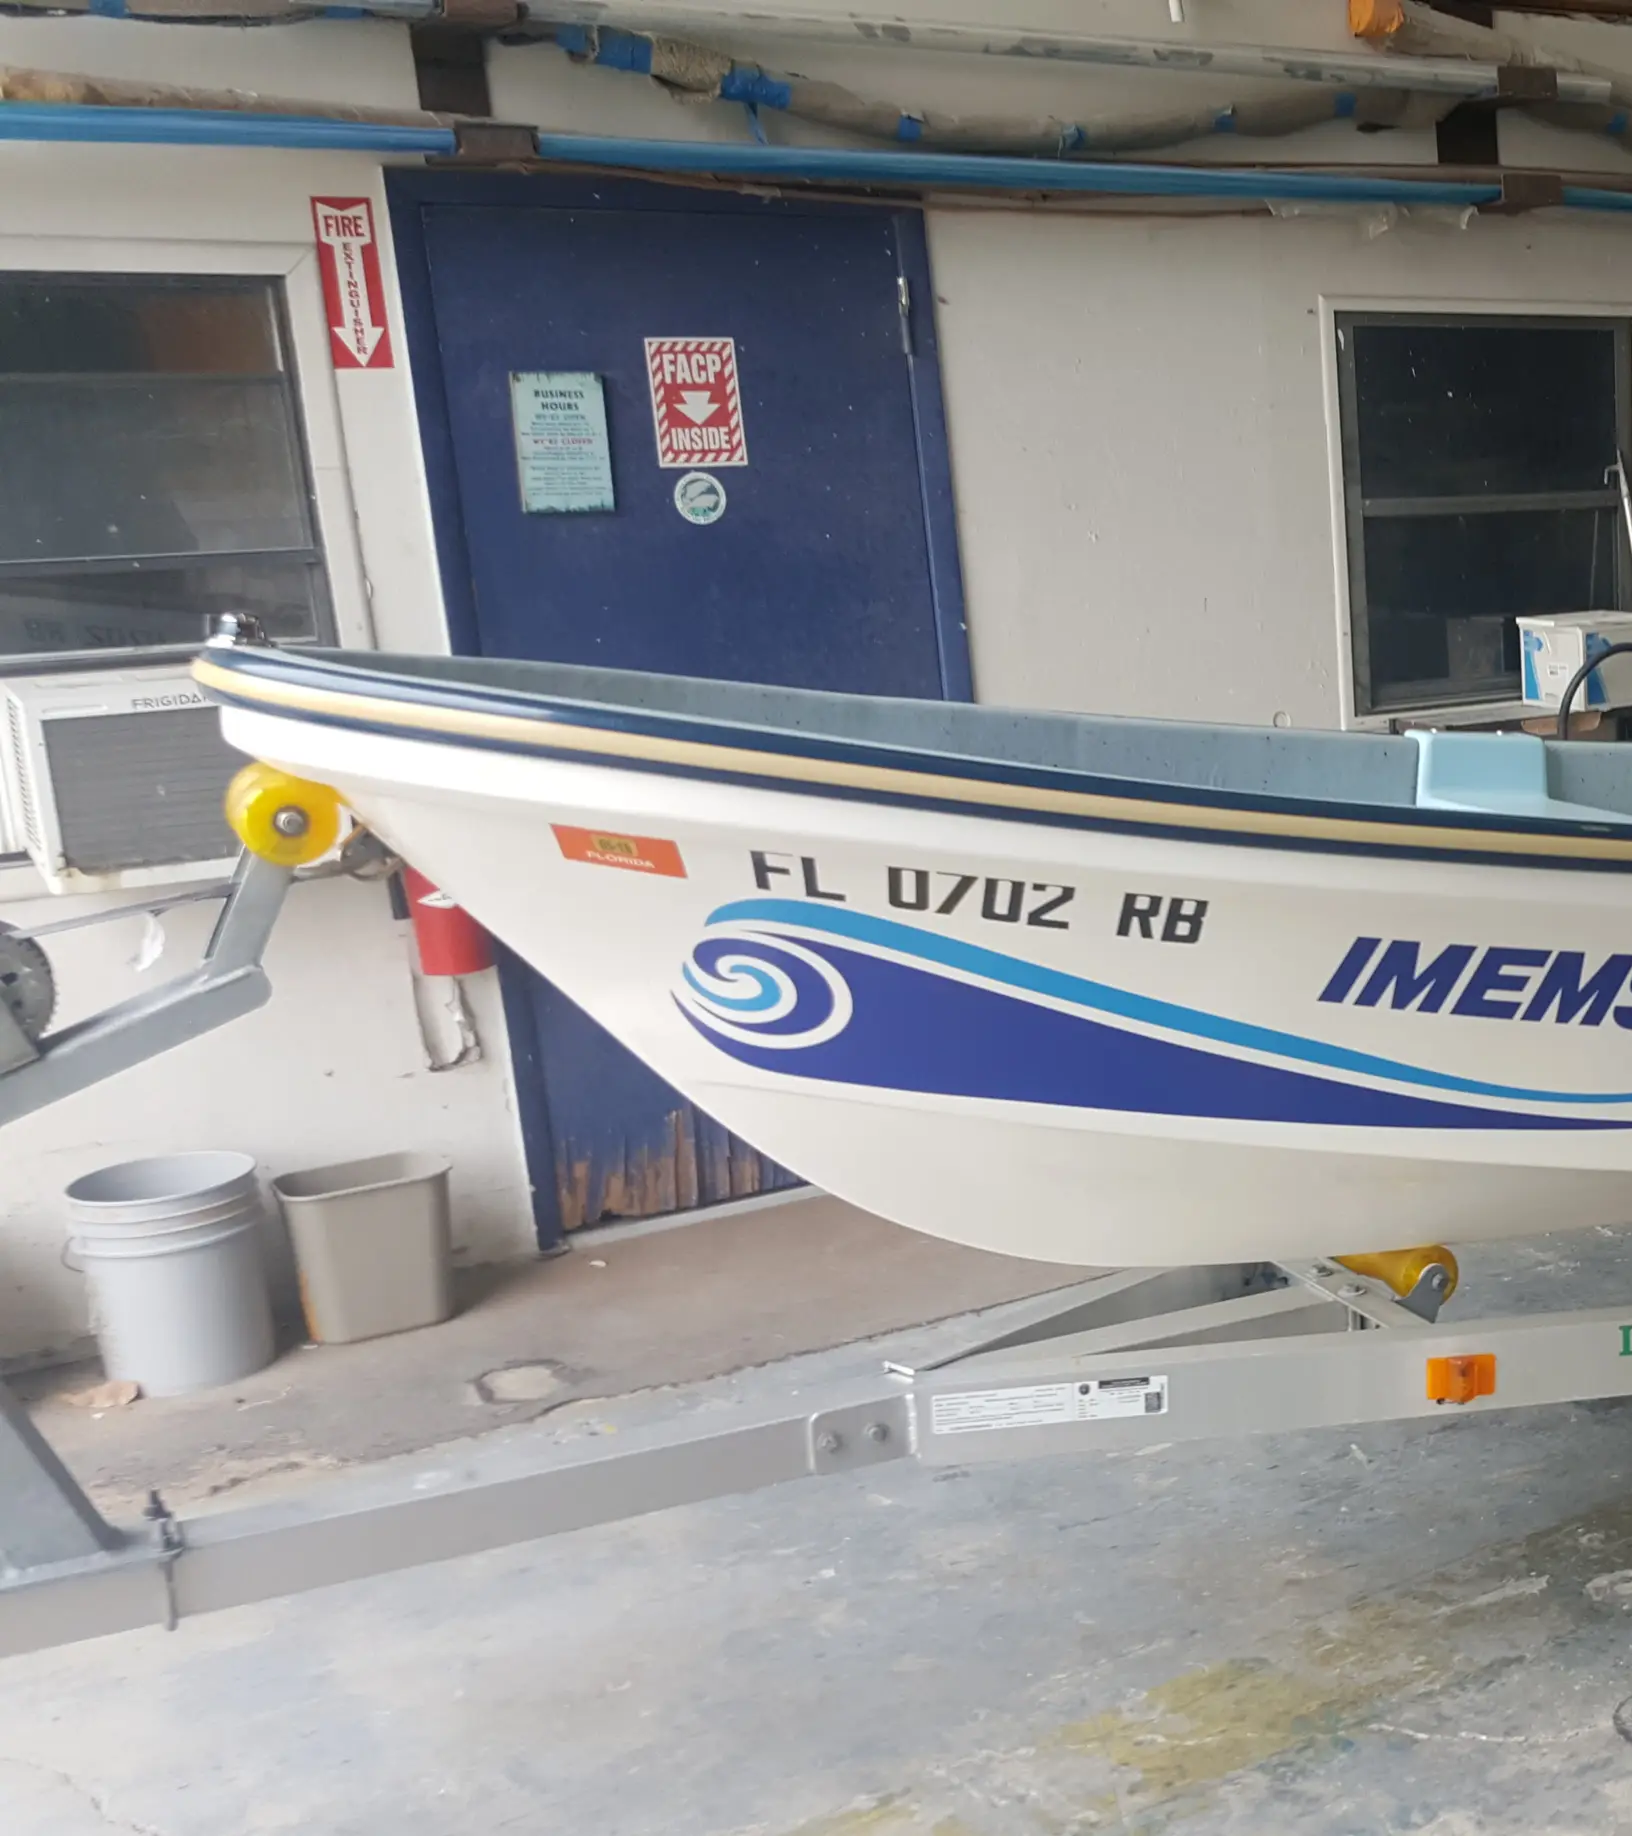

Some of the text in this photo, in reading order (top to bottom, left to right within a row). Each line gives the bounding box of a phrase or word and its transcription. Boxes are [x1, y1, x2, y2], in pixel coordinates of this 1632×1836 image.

[324, 215, 366, 237] FIRE
[342, 241, 368, 356] EXTINGUISHER
[662, 353, 722, 385] FACP
[534, 389, 585, 399] BUSINESS
[541, 401, 580, 411] HOURS
[670, 426, 732, 451] INSIDE
[585, 850, 656, 869] FLORIDA
[749, 849, 1210, 944] FL 0702 RB
